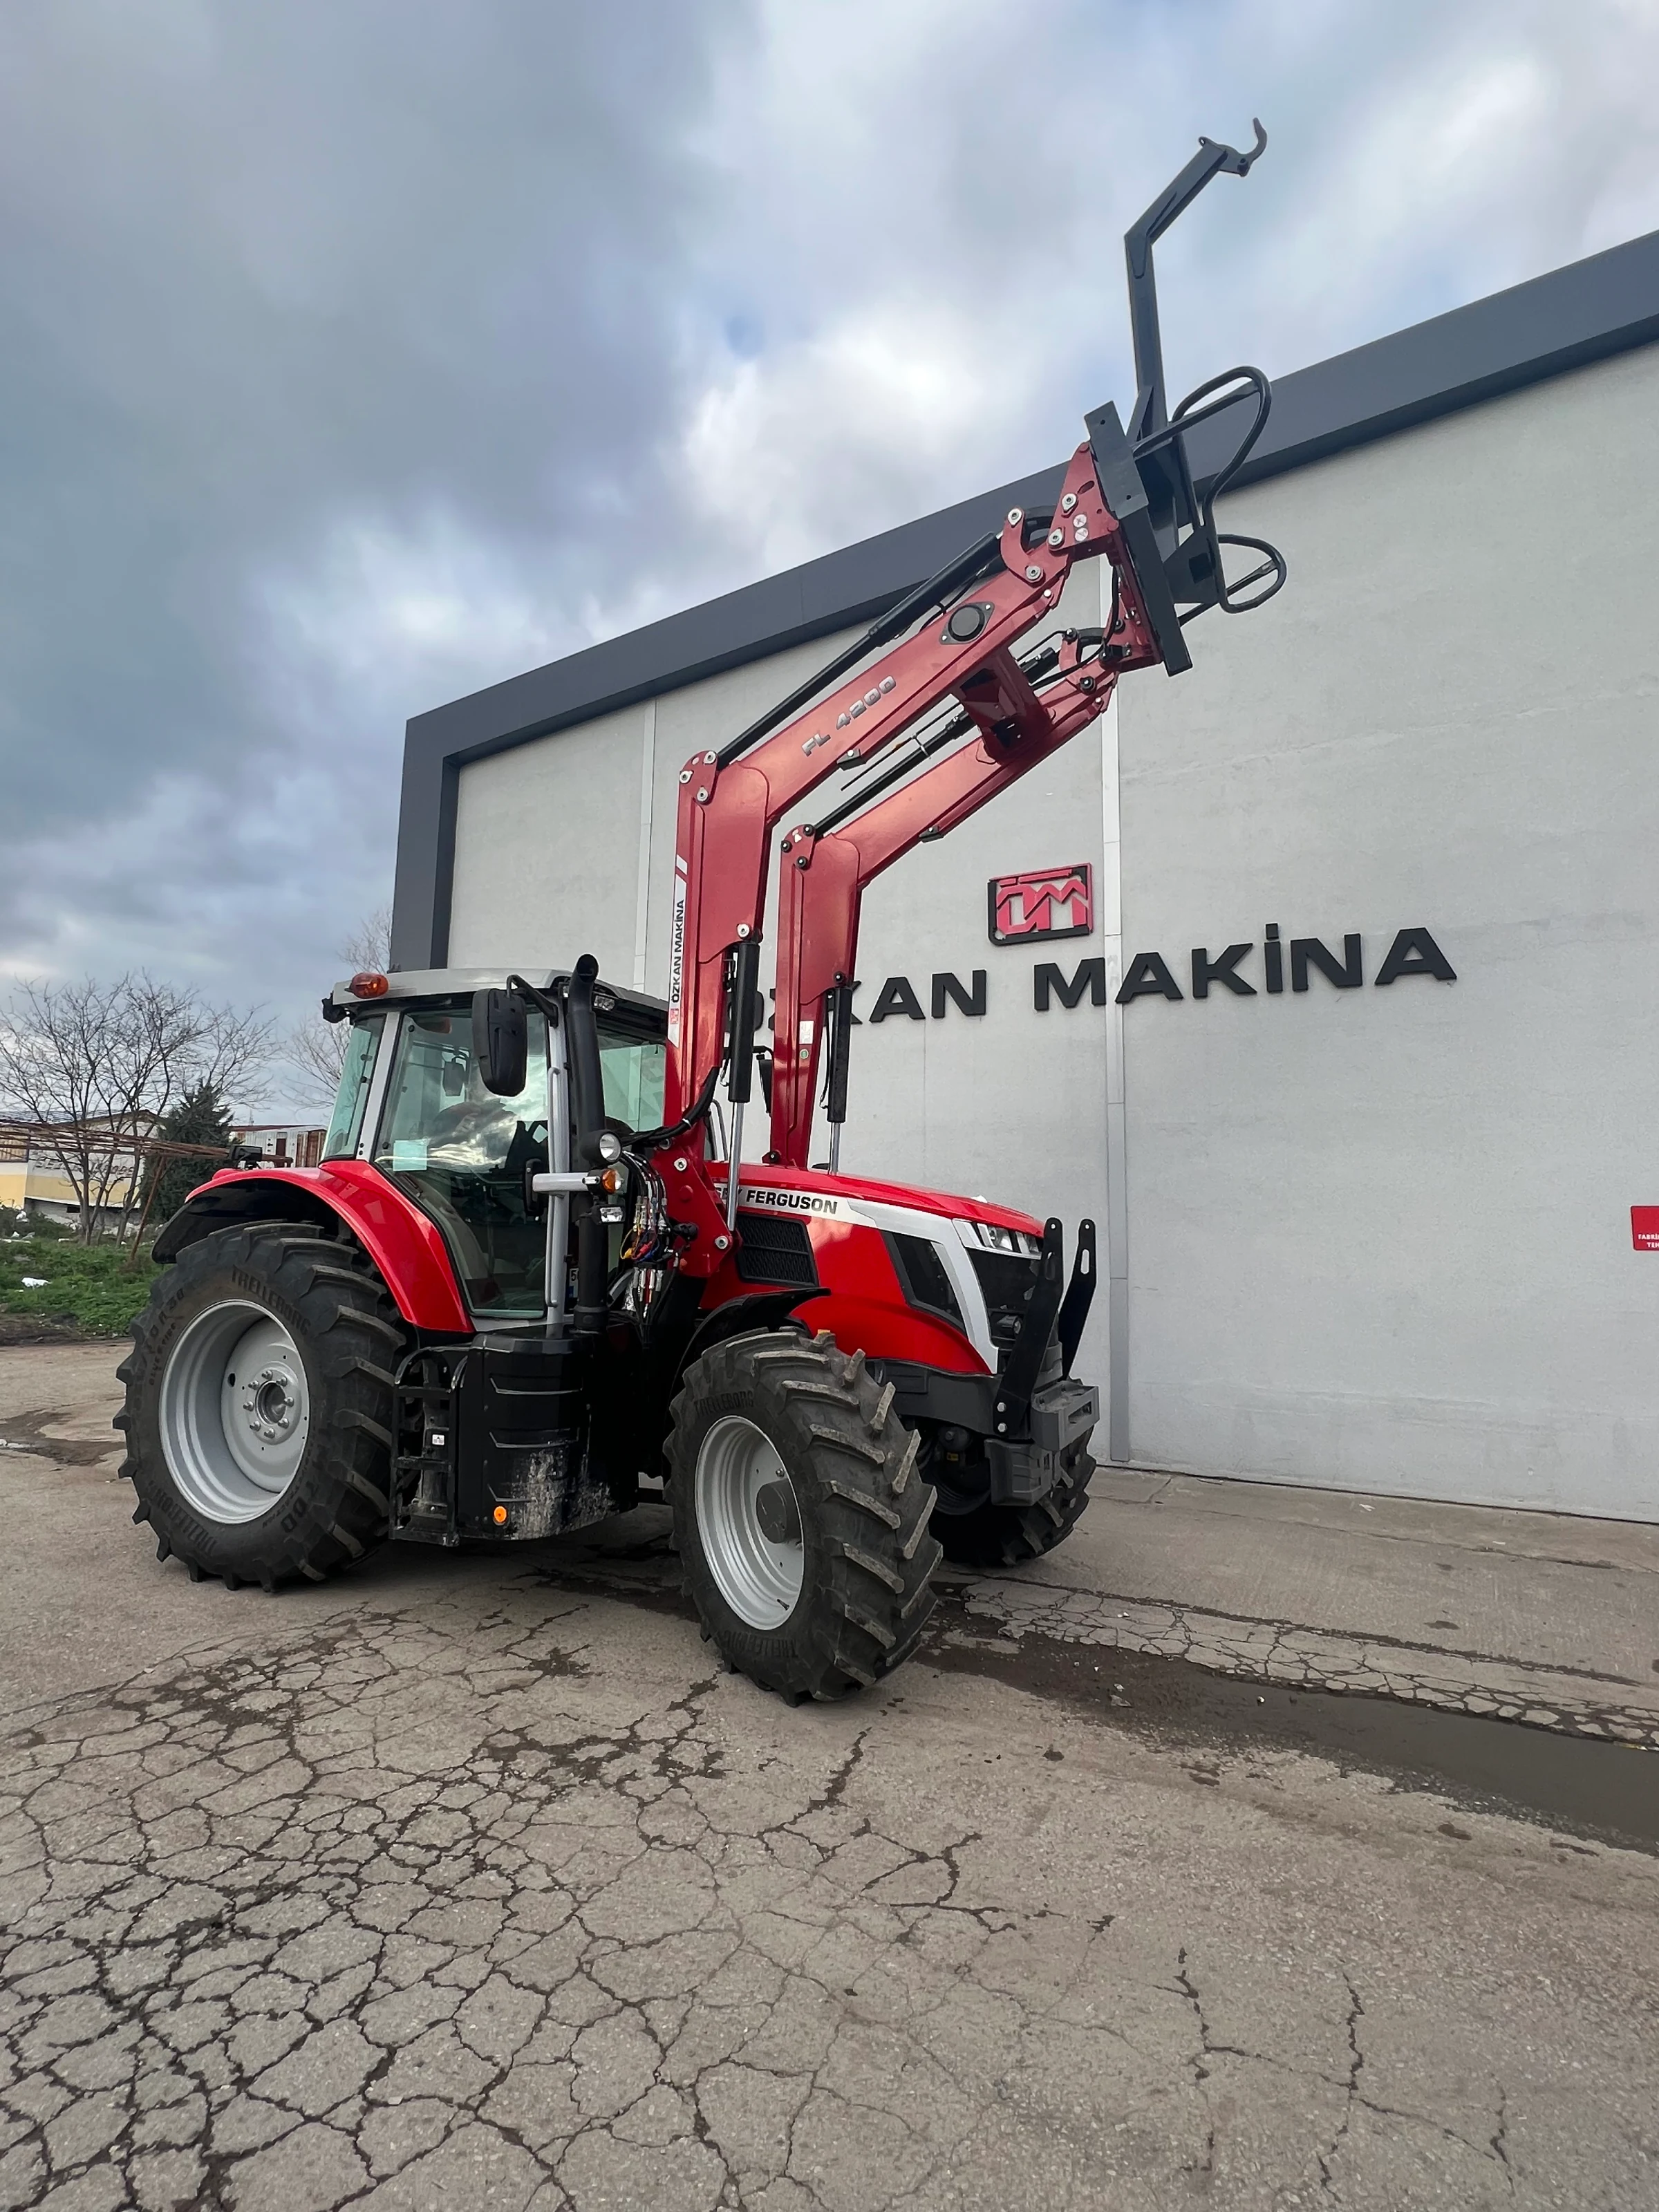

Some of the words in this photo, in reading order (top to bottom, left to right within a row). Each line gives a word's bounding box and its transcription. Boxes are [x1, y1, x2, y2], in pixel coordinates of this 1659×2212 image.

[801, 733, 832, 757] FL
[836, 675, 897, 731] 4200
[674, 899, 684, 953] MAKİNA
[671, 955, 682, 1003] ÖZKAN
[1034, 923, 1457, 1011] MAKİNA
[746, 1190, 838, 1215] FERGUSON
[232, 1264, 312, 1336] TRELLEBORG
[693, 1390, 755, 1419] TRELLEBORG
